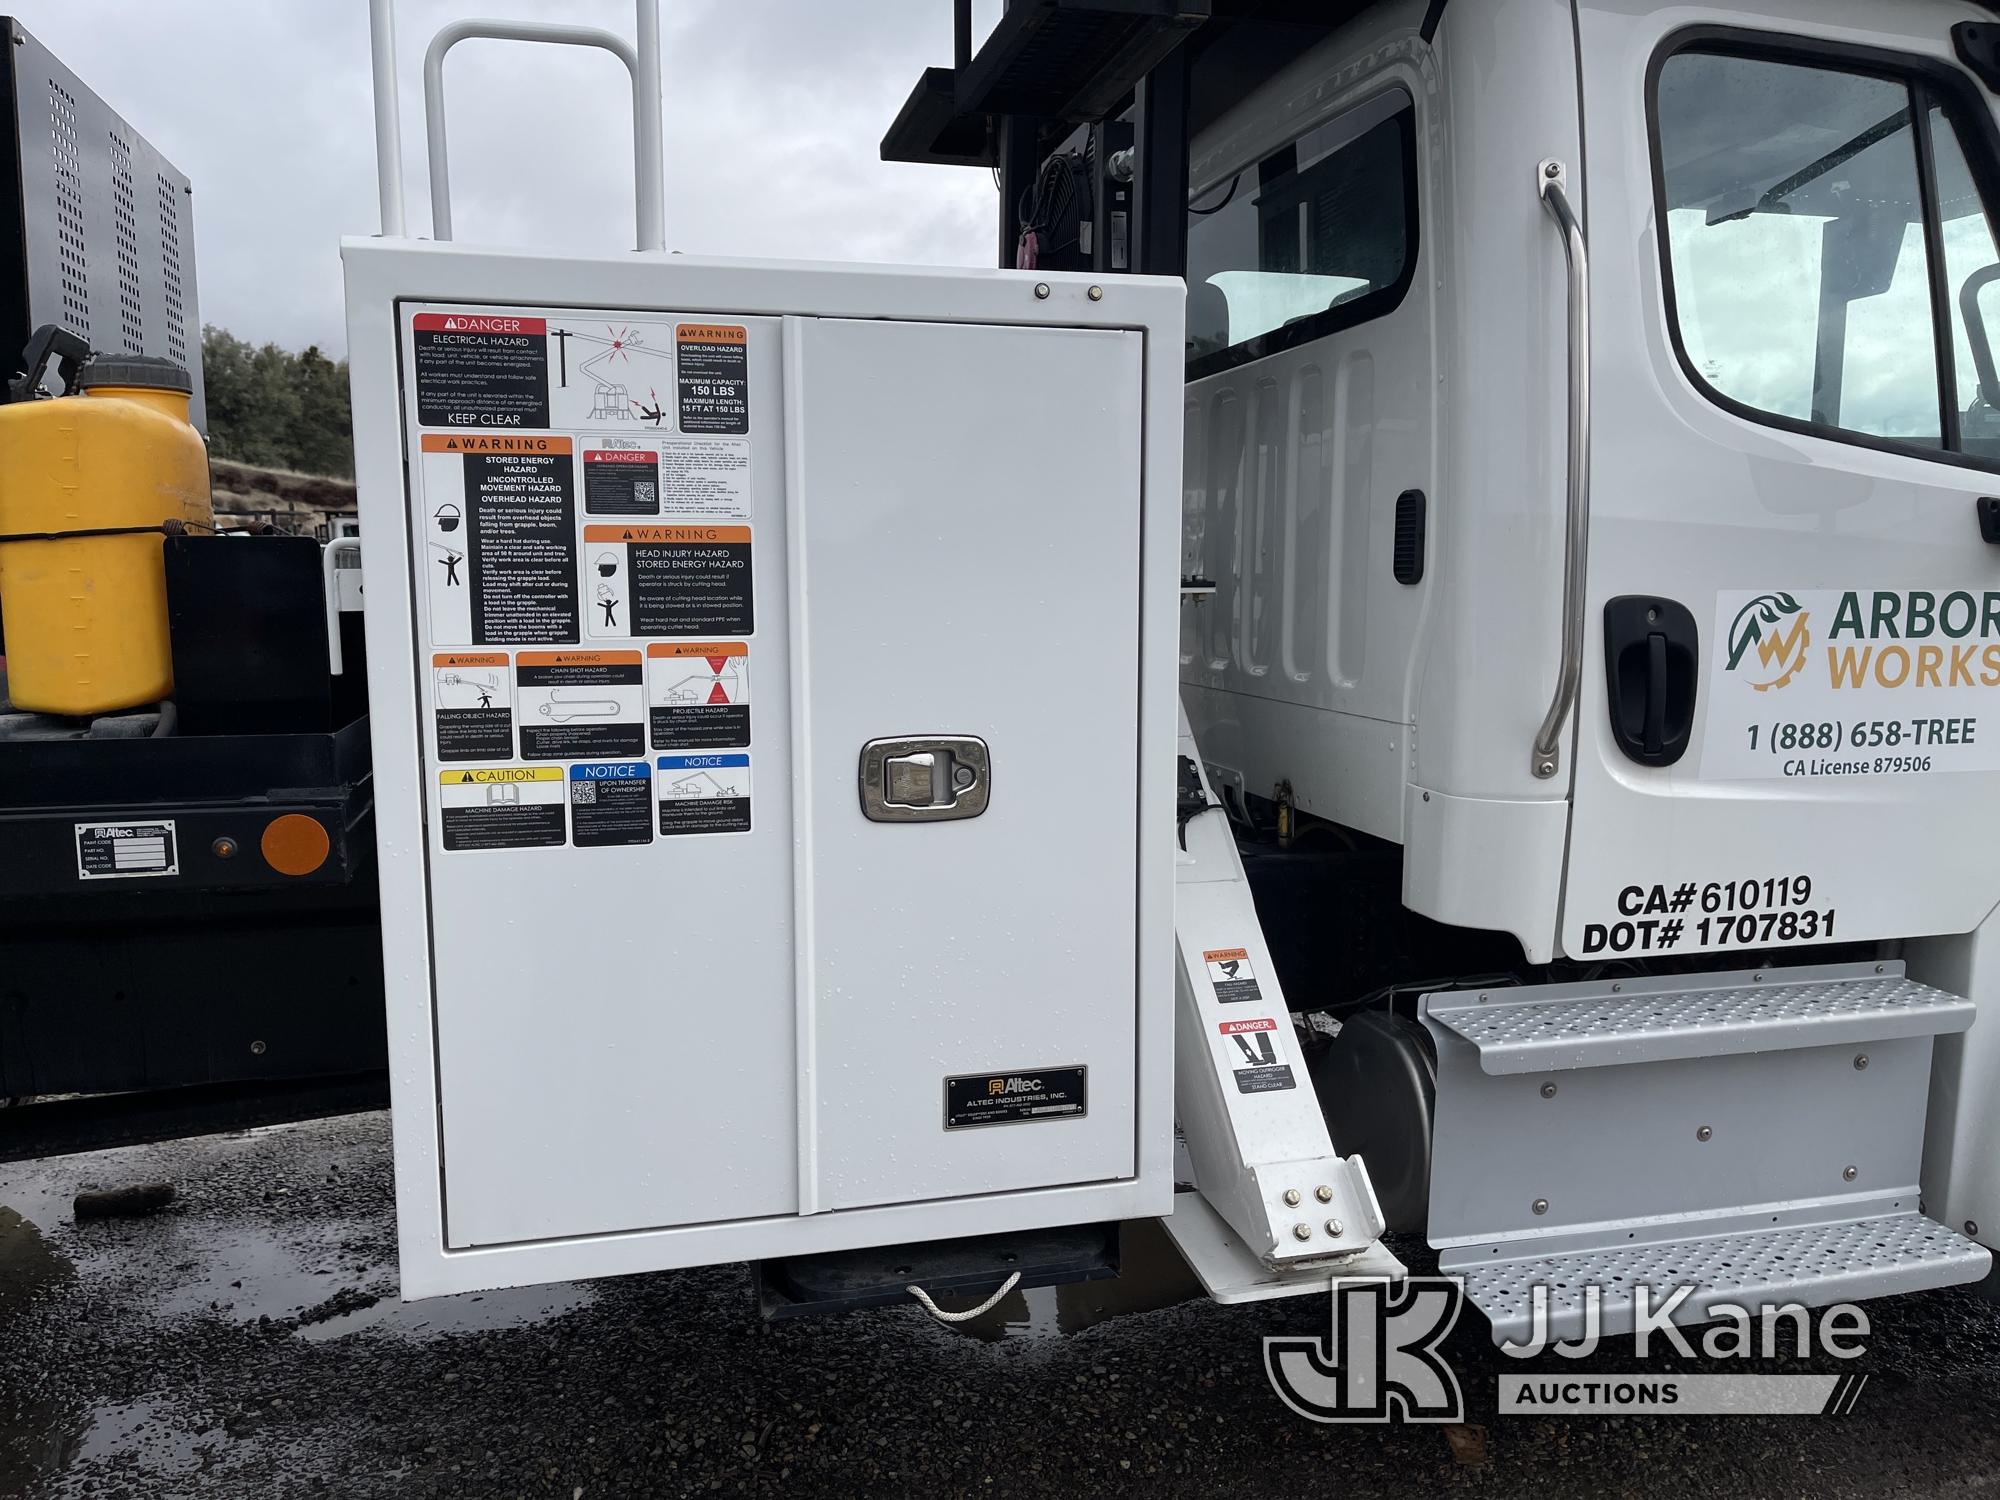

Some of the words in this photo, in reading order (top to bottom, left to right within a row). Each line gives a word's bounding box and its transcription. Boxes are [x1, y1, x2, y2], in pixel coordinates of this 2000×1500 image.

[457, 318, 520, 332] DANGER
[688, 330, 744, 338] WARNING
[433, 335, 488, 345] ELECTRICAL
[490, 337, 529, 346] HAZARD
[691, 386, 709, 395] 150
[712, 386, 735, 395] LBS
[448, 413, 476, 424] KEEP
[480, 414, 521, 425] CLEAR
[463, 439, 547, 450] WARNING
[605, 453, 646, 461] DANGER
[487, 476, 554, 484] UNCONTROLLED
[637, 529, 717, 540] WARNING
[636, 560, 670, 568] STORED
[671, 560, 706, 568] ENERGY
[708, 560, 744, 568] HAZARD
[457, 656, 495, 664] WARNING
[1827, 645, 2000, 689] WORKS
[1747, 724, 1759, 750] 1
[1771, 721, 1842, 753] (888)
[1851, 718, 1976, 748] 658-TREE
[684, 757, 722, 767] NOTICE
[1783, 760, 1806, 776] CA
[1811, 758, 1869, 775] License
[1873, 756, 1931, 773] 879506
[476, 770, 535, 781] CAUTION
[585, 765, 635, 777] NOTICE
[106, 829, 133, 838] Altec
[1582, 918, 1684, 953] DOT#
[1696, 909, 1835, 945] 1707831
[1212, 951, 1246, 959] WARNING
[1236, 1021, 1271, 1032] DANGER
[1258, 1066, 1285, 1074] OUTRIGGER
[1005, 1077, 1042, 1093] Altec
[966, 1099, 993, 1107] ALTEC
[994, 1094, 1048, 1102] INDUSTRIES,
